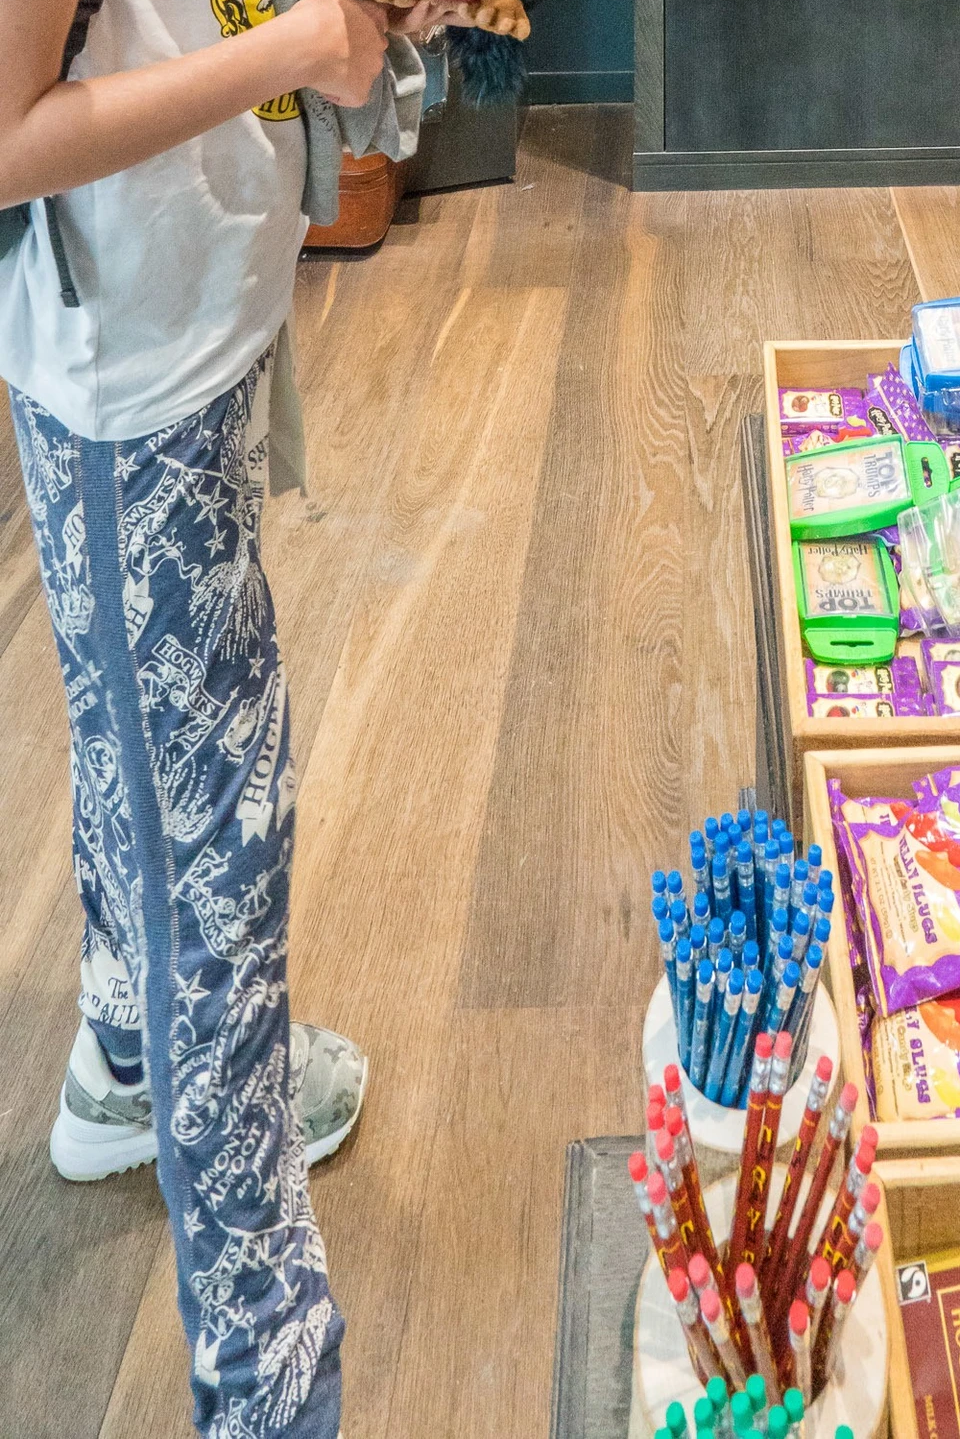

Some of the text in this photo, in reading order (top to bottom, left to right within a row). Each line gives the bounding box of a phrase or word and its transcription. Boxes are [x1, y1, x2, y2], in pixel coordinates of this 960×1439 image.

[863, 454, 881, 498] TRUMPS
[877, 450, 900, 494] TOP
[840, 543, 868, 557] Harry
[815, 588, 874, 599] TRUMPS
[818, 596, 875, 610] TOP
[158, 641, 216, 717] HOGWARTS
[107, 977, 129, 1000] The
[909, 1038, 931, 1104] SLUGS
